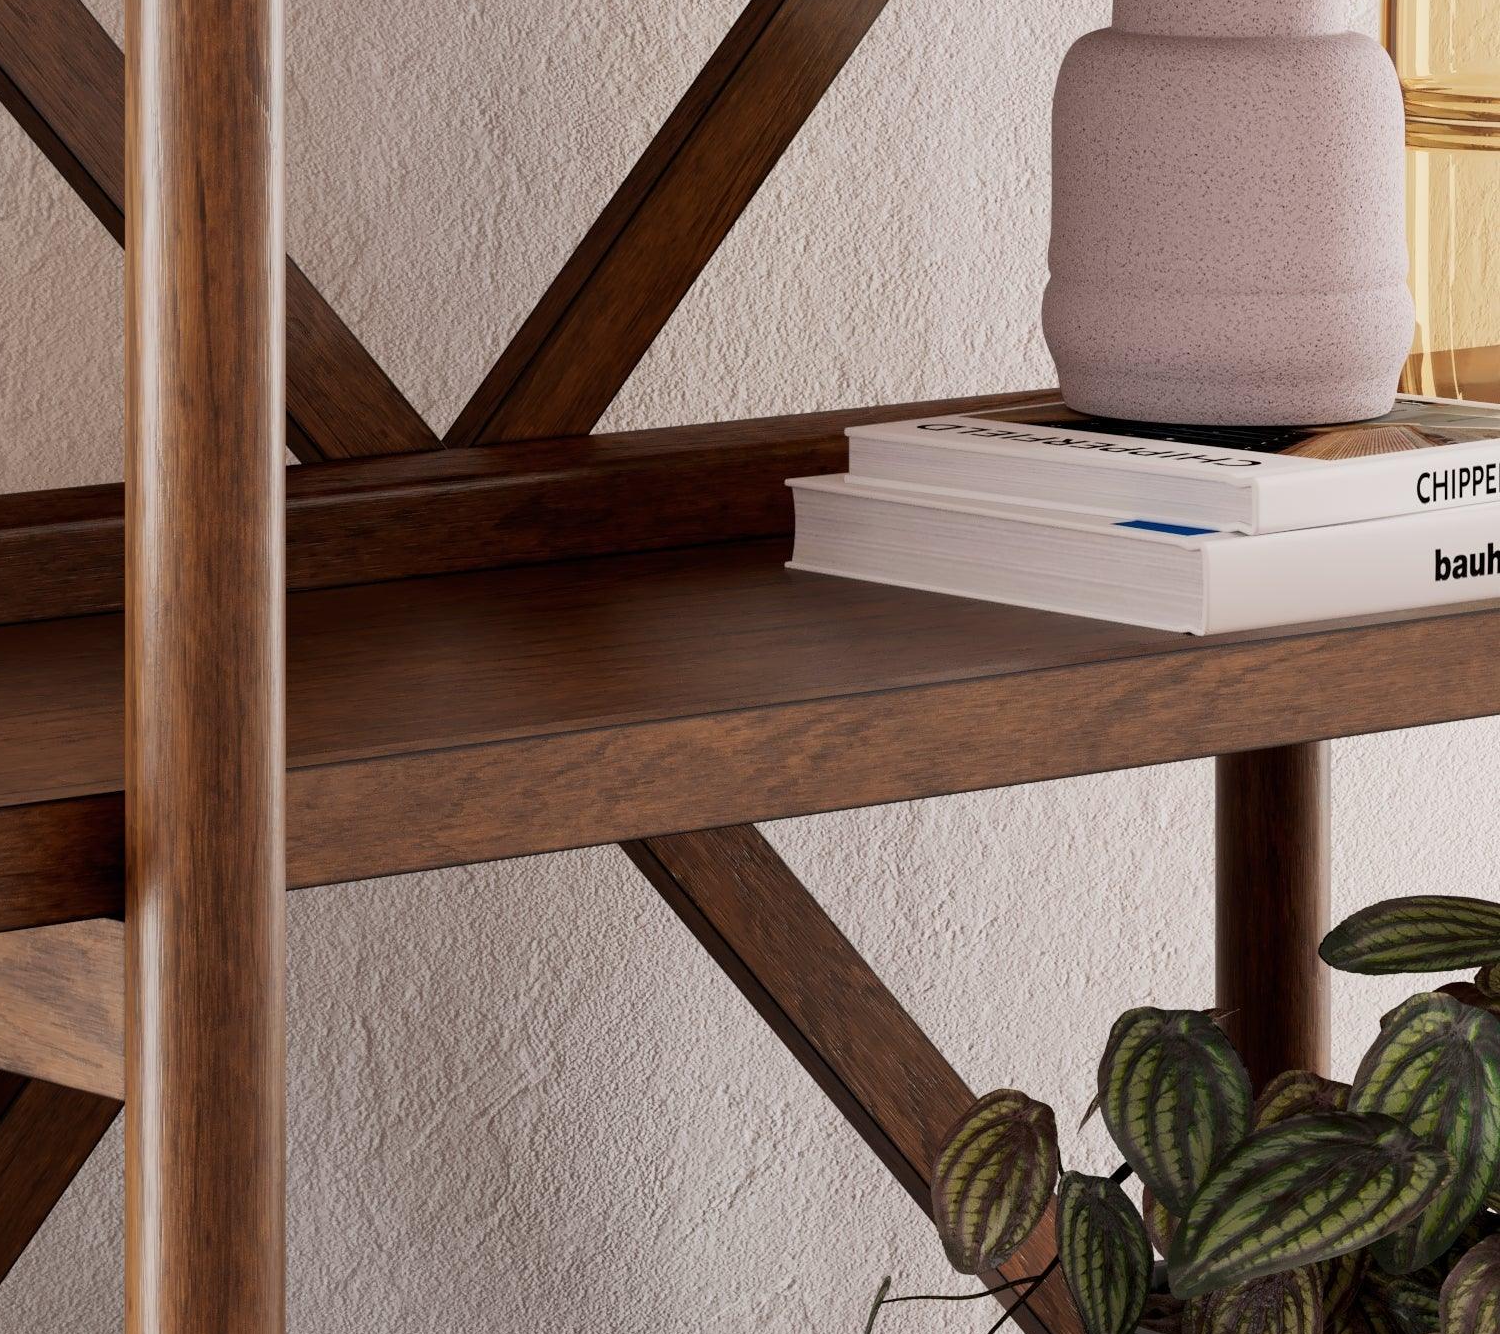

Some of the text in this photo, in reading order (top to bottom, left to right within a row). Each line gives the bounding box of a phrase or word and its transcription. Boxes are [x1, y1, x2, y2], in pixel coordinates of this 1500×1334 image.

[916, 423, 1262, 467] CHIPPERFIELD
[1416, 463, 1500, 504] CHIPPE
[1435, 542, 1500, 582] bauh
